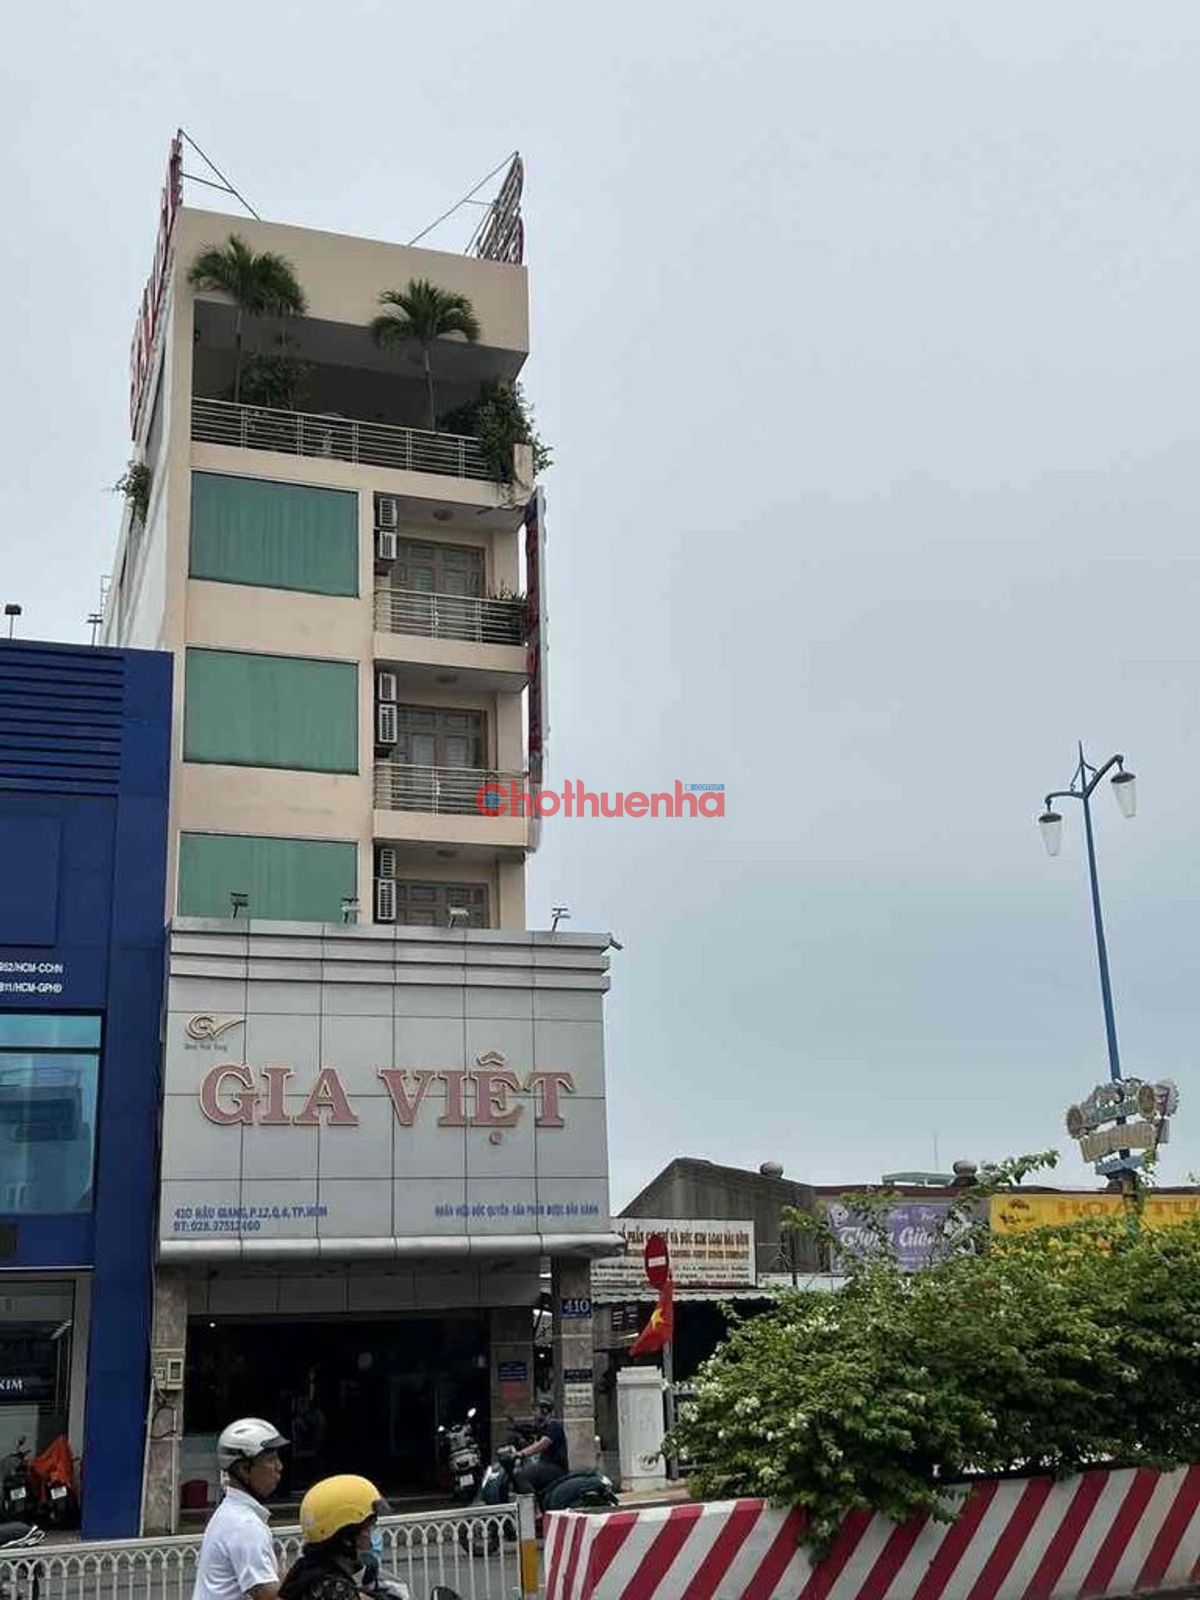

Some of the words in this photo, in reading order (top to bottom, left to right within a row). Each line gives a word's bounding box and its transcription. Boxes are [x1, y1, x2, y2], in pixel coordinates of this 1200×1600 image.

[199, 1062, 359, 1127] GIA
[377, 1050, 575, 1146] VIỆT
[563, 1300, 589, 1313] 410
